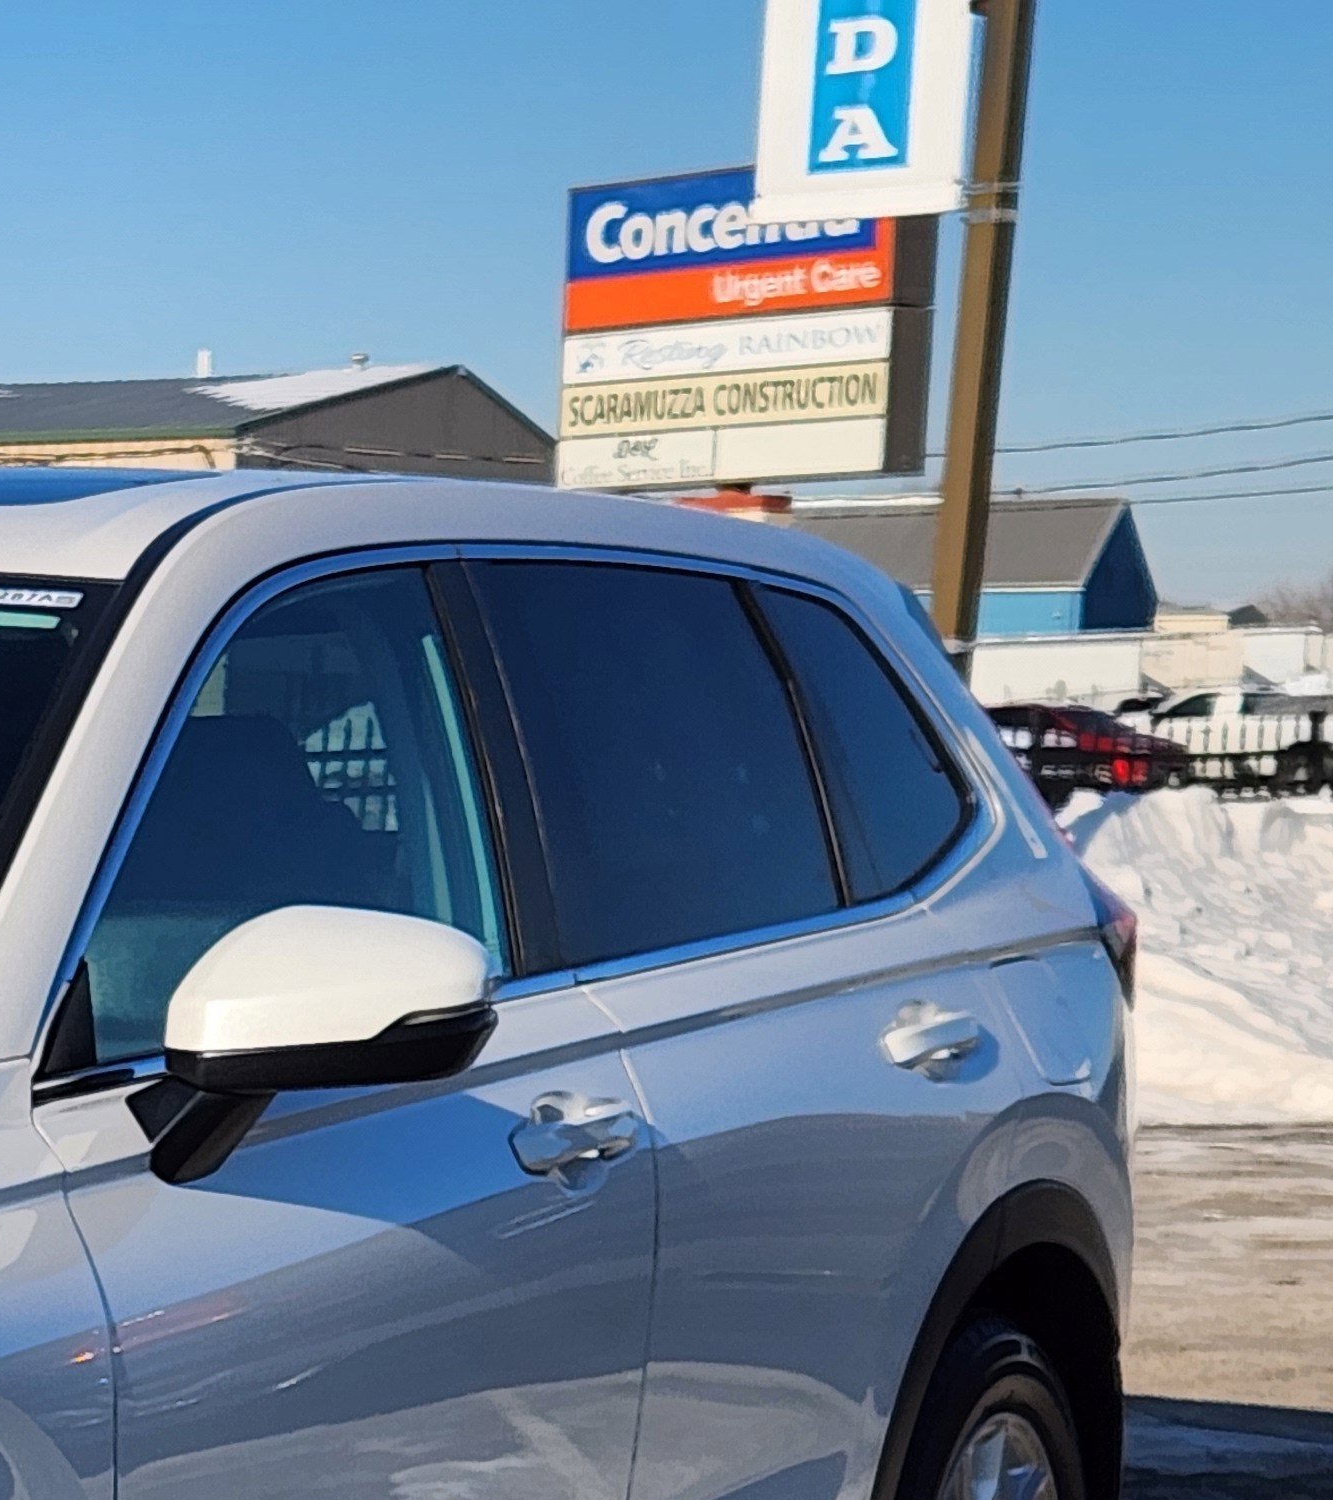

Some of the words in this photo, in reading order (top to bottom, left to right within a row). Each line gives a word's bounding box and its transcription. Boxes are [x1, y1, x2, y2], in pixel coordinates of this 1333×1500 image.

[713, 265, 806, 306] Urgent
[810, 258, 882, 293] Care
[738, 326, 877, 356] RAINBOW
[568, 386, 706, 427] SCARAMUZZA
[713, 372, 878, 416] CONSTRUCTION
